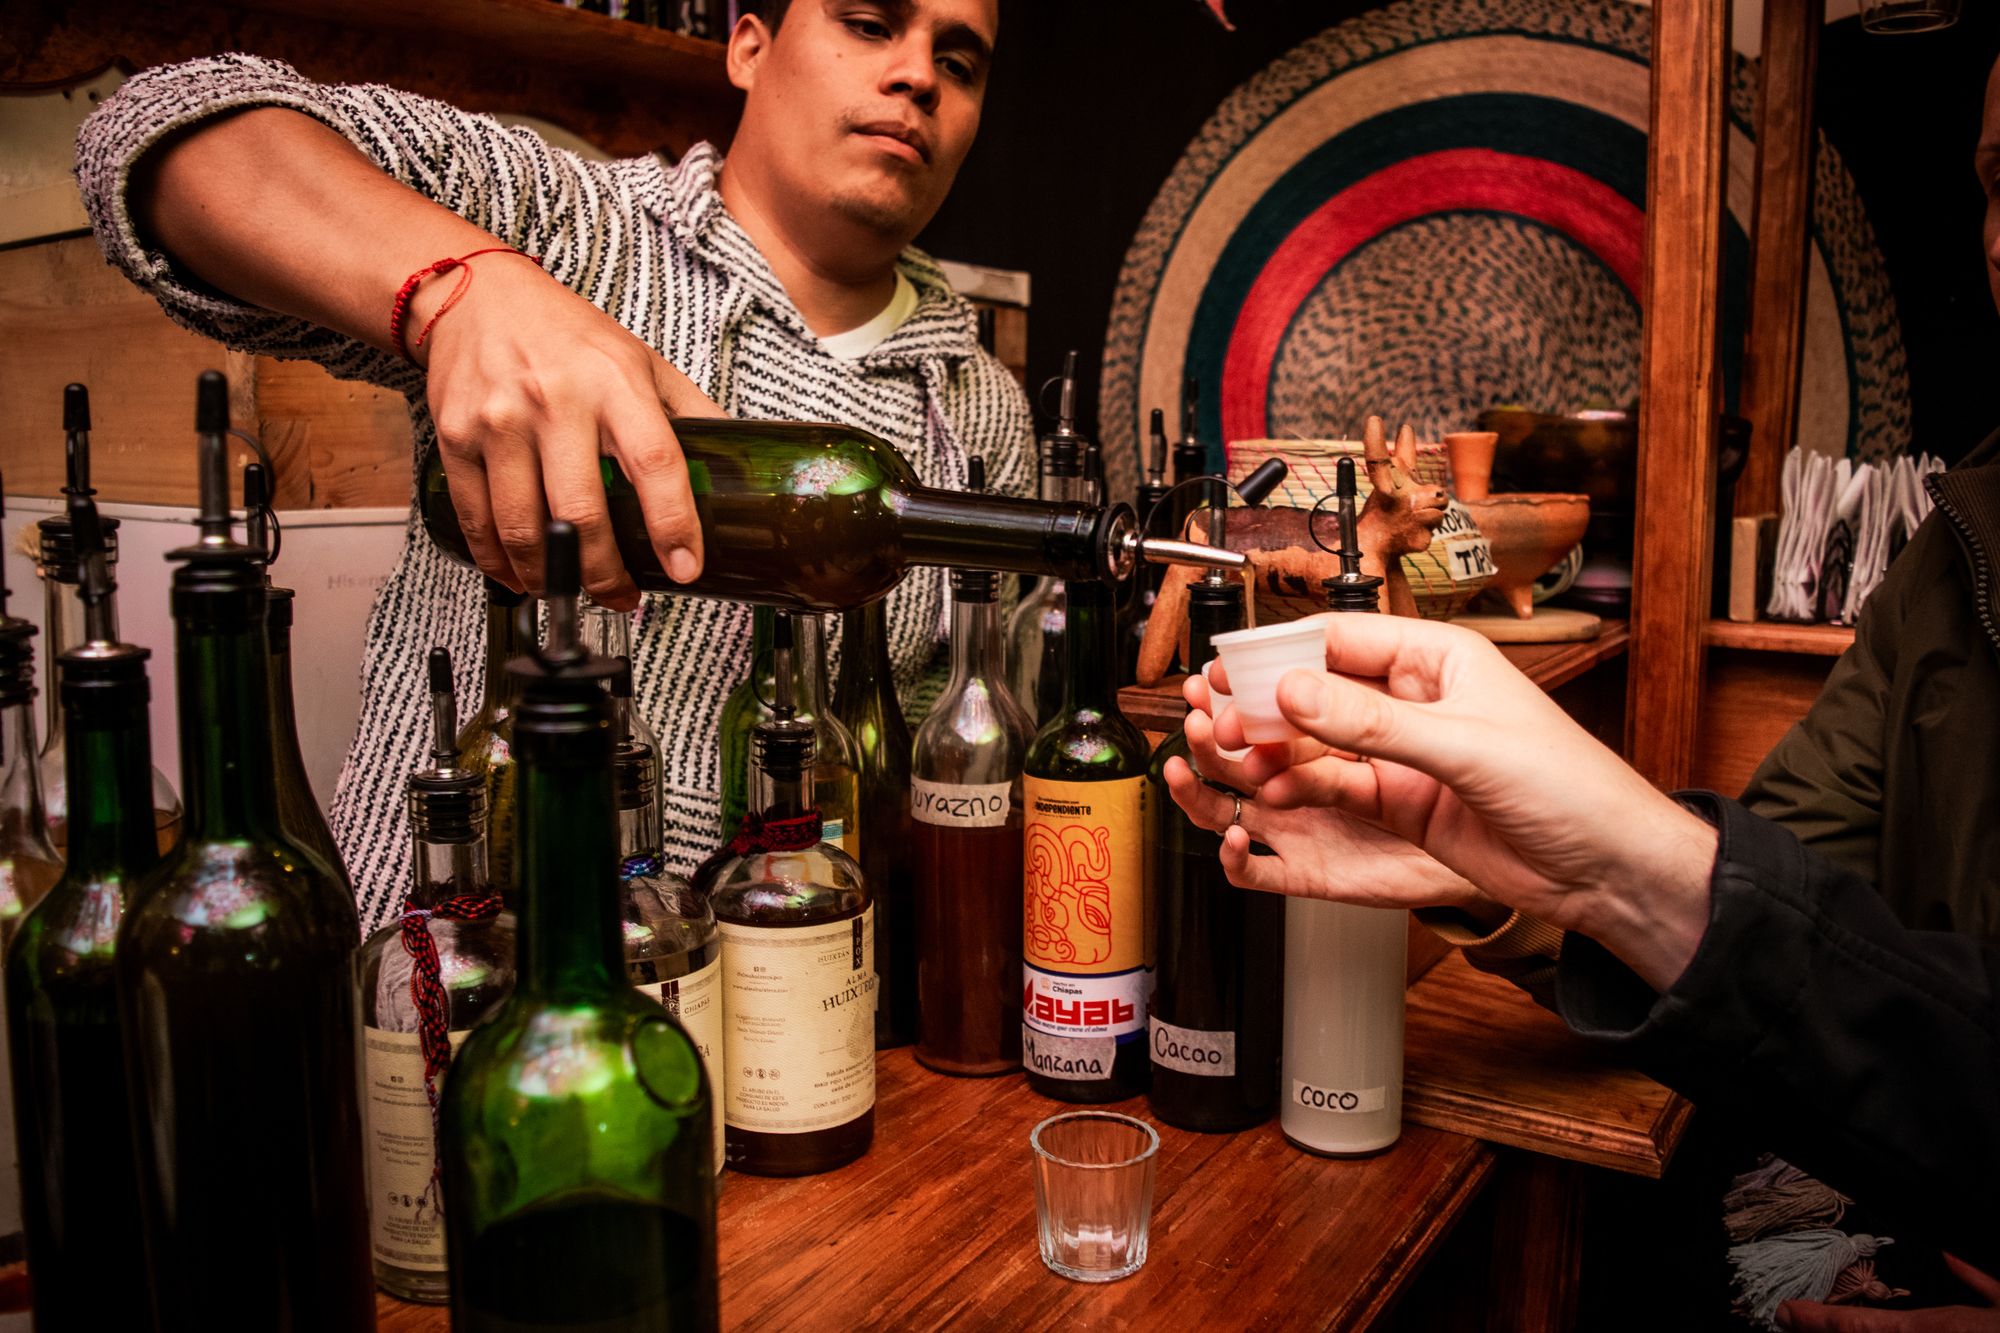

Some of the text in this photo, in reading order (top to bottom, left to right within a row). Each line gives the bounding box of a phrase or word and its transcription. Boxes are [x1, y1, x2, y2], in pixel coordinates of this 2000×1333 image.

[846, 970, 867, 986] ALMA
[1052, 986, 1083, 995] Chiapas
[1024, 1037, 1104, 1075] Manzana
[1155, 1027, 1222, 1064] Cacao
